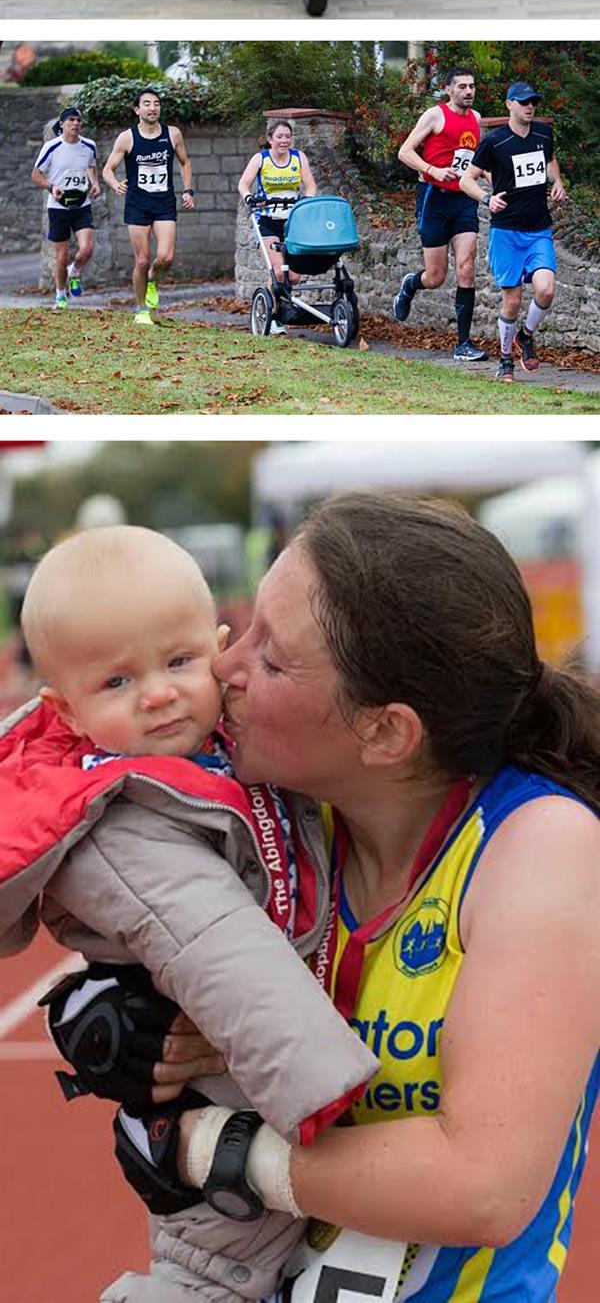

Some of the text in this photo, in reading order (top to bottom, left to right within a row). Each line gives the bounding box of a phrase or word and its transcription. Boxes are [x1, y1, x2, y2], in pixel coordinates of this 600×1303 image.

[515, 161, 546, 178] 154
[64, 176, 87, 187] 794
[138, 173, 167, 185] 317
[249, 786, 288, 915] The Abingdon
